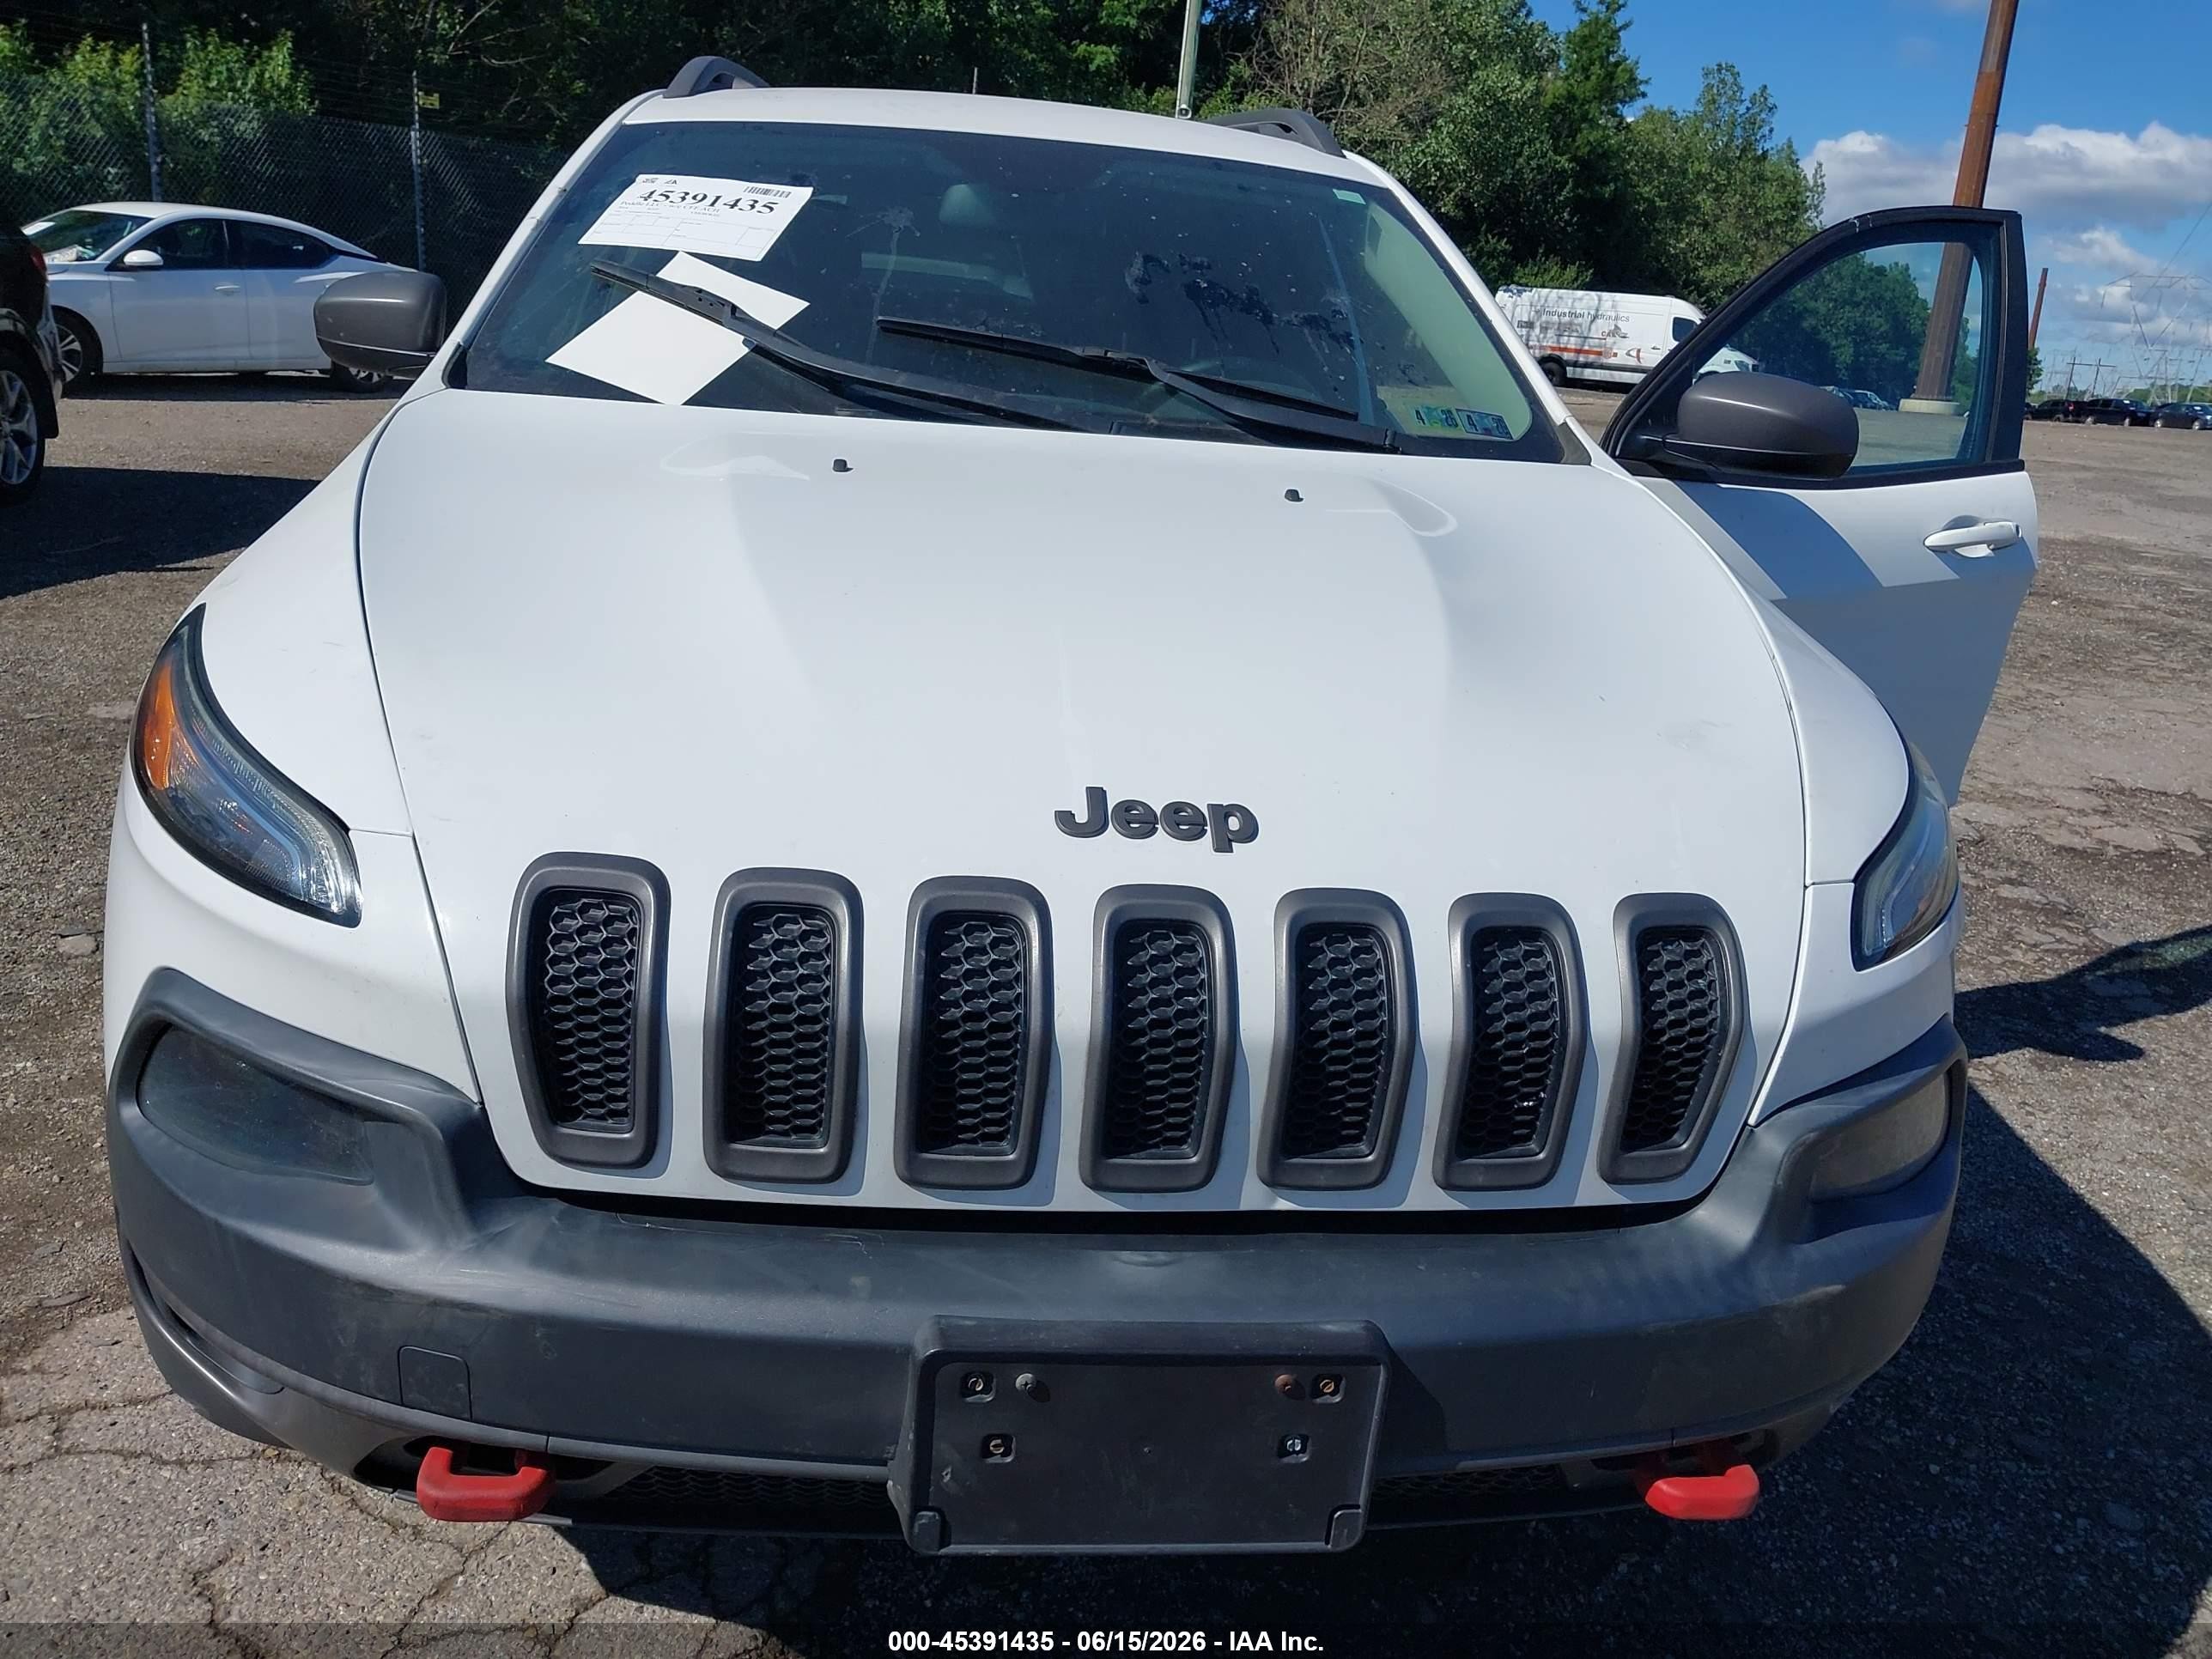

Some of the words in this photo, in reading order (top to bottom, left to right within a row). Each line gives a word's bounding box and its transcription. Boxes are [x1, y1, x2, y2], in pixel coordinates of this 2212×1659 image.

[638, 188, 780, 216] 45391435
[1542, 308, 1585, 319] Industrial
[1587, 311, 1630, 323] hydraulics
[1414, 409, 1426, 426] 4
[1440, 409, 1459, 428] 26
[1466, 414, 1479, 432] 4
[1054, 786, 1260, 853] Jeep
